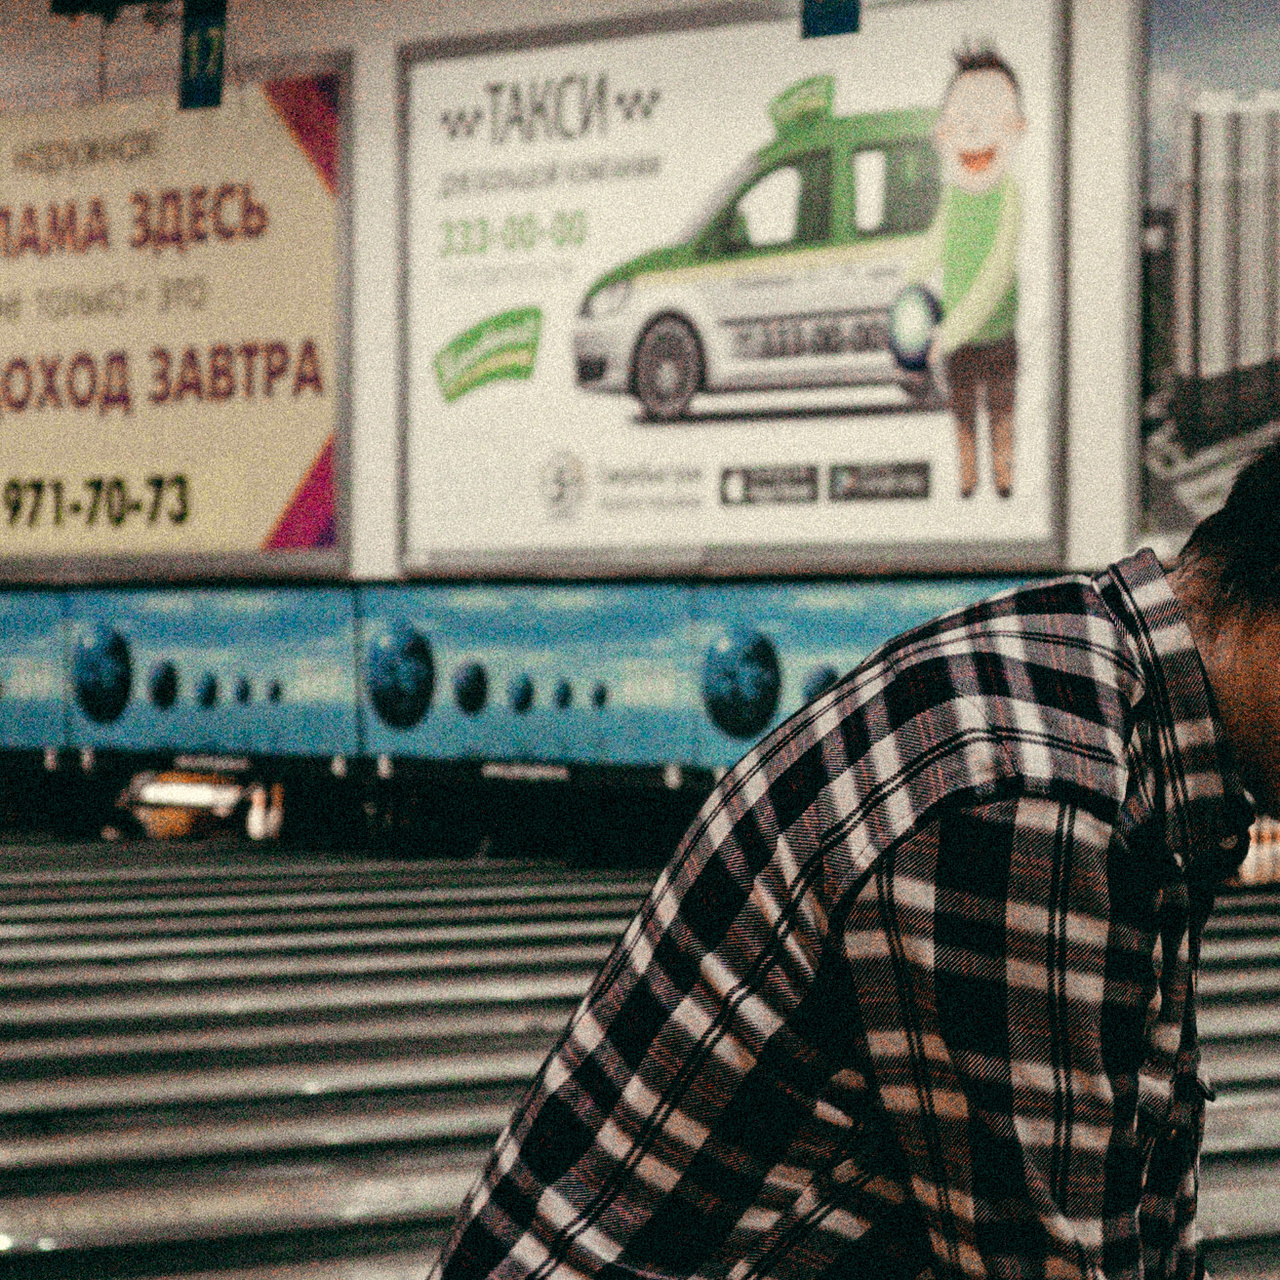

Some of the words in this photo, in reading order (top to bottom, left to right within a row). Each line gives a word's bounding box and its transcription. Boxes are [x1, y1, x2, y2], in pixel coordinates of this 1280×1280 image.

[484, 71, 608, 144] ТАКСИ
[129, 181, 271, 257] ЗДЕСЬ
[148, 338, 325, 406] ЗАВТРА
[4, 473, 190, 529] 971-70-73
